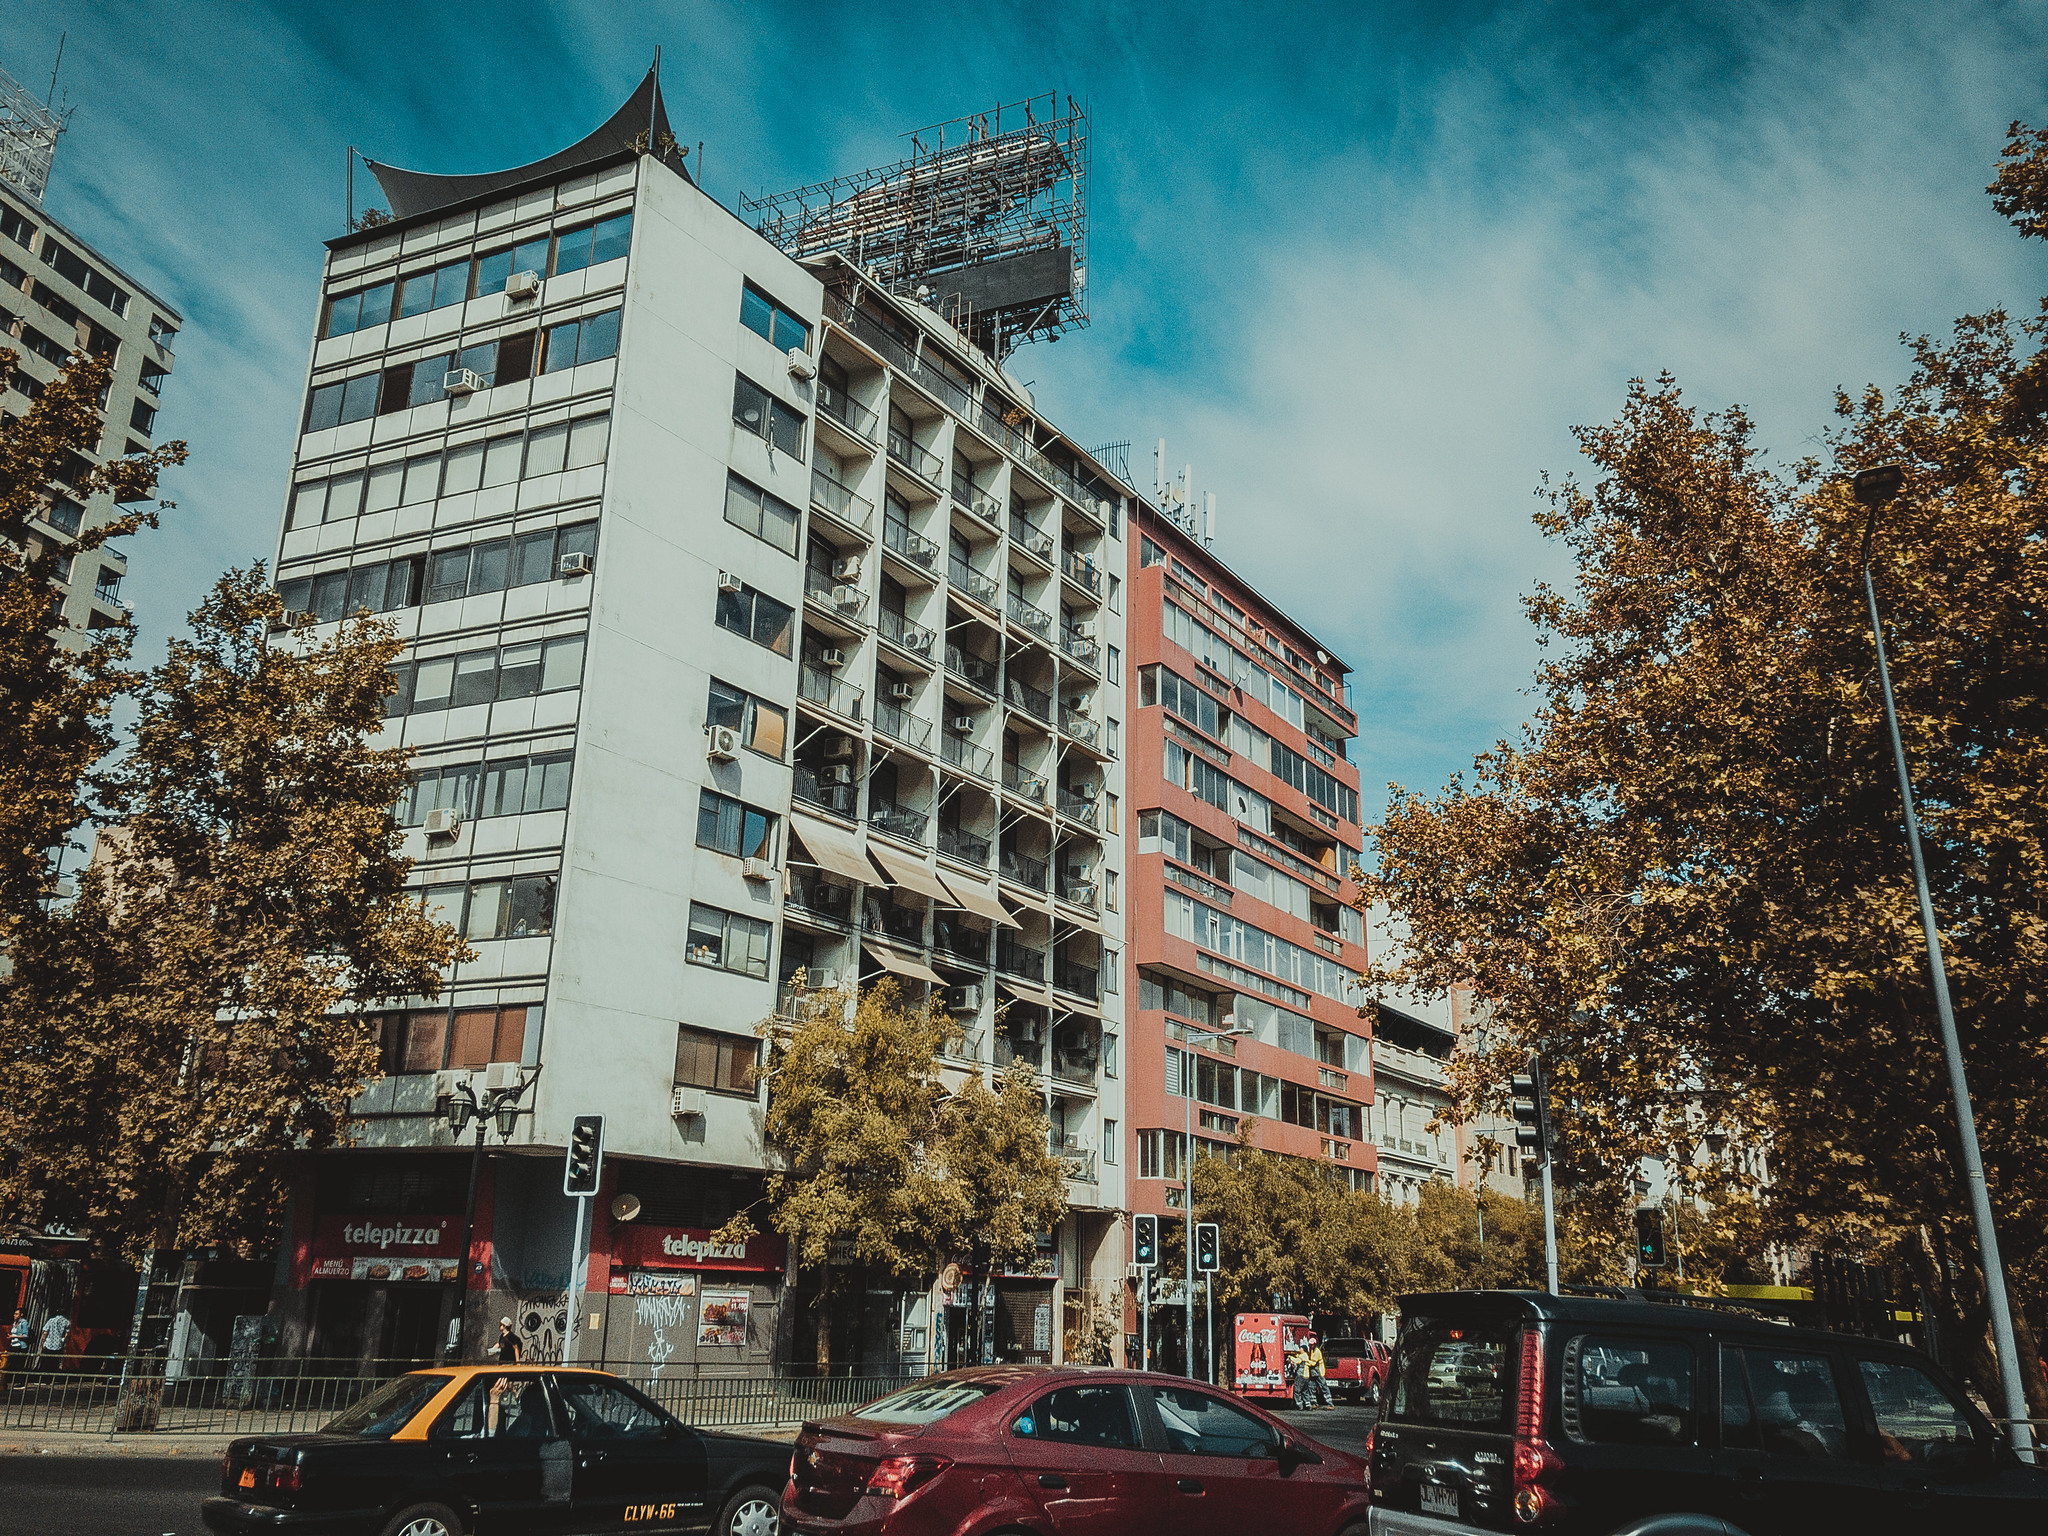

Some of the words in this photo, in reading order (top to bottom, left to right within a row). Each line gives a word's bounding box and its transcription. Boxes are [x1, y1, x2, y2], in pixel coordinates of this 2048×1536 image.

[343, 1222, 440, 1249] telepizza
[662, 1234, 746, 1263] telepizza
[314, 1266, 350, 1276] ALMUERZO
[1238, 1328, 1277, 1344] CocaCola
